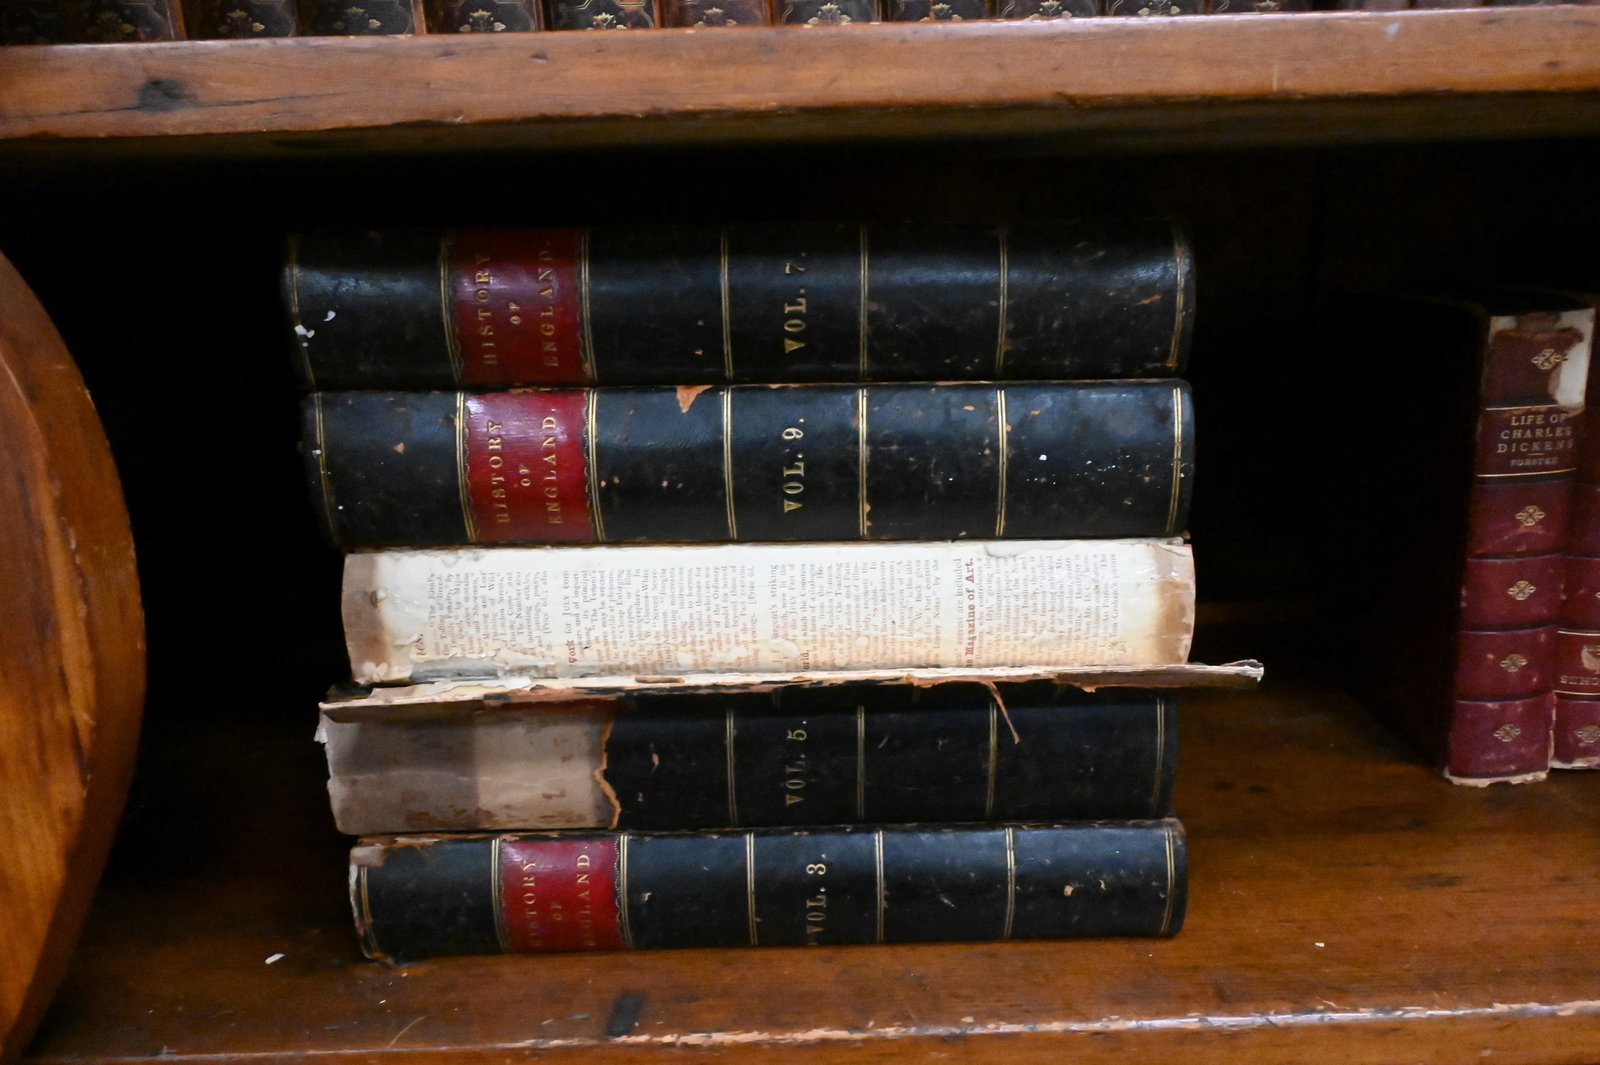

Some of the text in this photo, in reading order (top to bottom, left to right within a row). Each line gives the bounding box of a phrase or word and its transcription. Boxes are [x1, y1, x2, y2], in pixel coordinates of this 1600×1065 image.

[475, 254, 497, 365] HISTORY
[508, 303, 521, 325] OF
[784, 253, 806, 354] VOL. 7.
[1500, 426, 1572, 439] CHARLES
[1511, 415, 1544, 426] LIFE
[487, 421, 509, 523] HISTORY
[519, 464, 531, 486] OF
[542, 409, 562, 524] ENGLAND.
[782, 418, 804, 513] VOL. 9.
[965, 558, 975, 583] Art.
[965, 604, 976, 655] Magazine
[785, 721, 807, 806] VOL. 5.
[551, 903, 562, 920] OF
[806, 854, 826, 934] VOL. 3.
